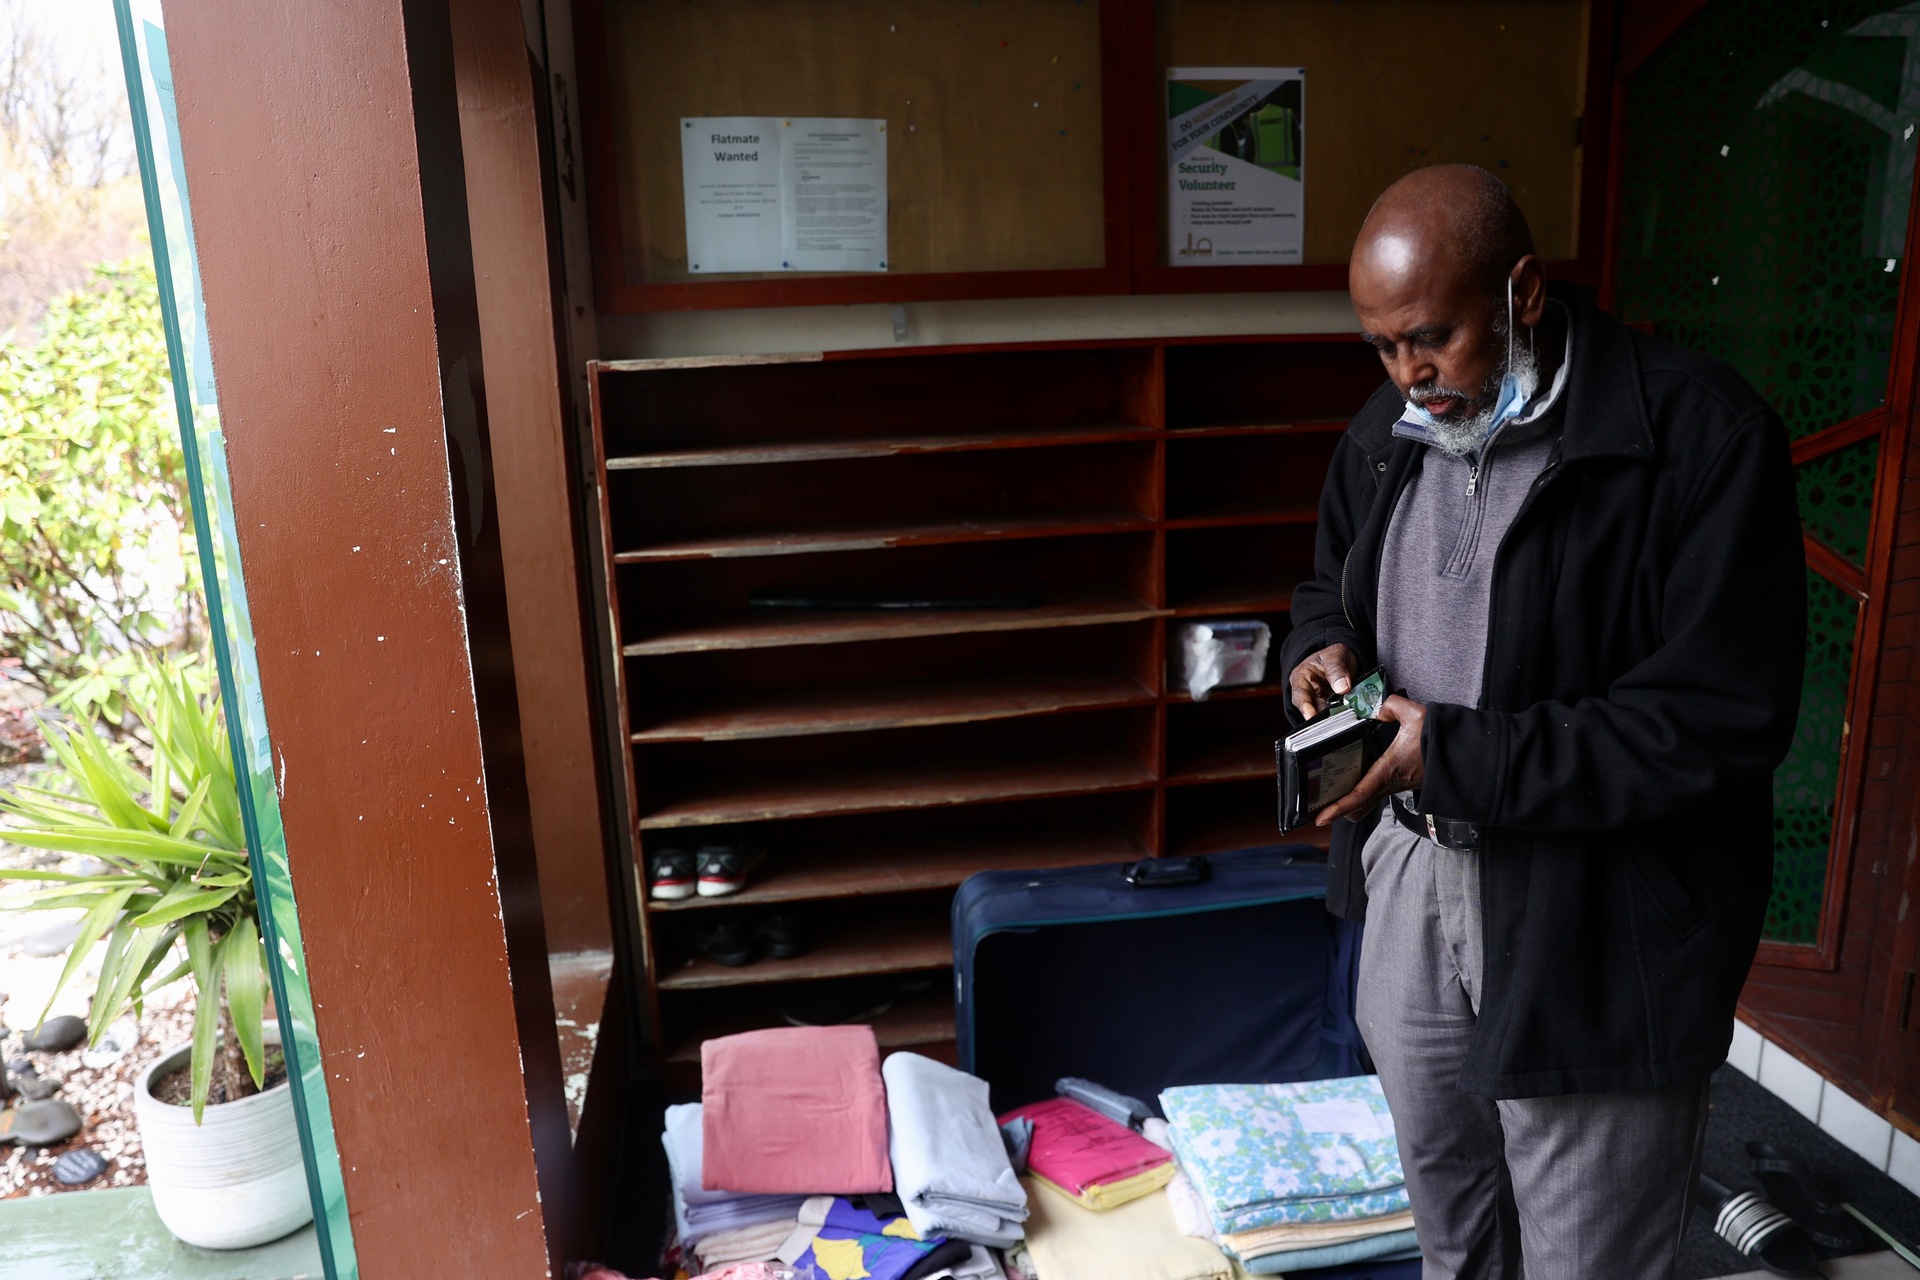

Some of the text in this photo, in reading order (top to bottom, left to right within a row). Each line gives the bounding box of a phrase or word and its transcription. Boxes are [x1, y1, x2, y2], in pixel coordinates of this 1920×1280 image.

[1171, 136, 1190, 151] FOR
[1188, 123, 1211, 140] YOUR
[1210, 93, 1258, 128] COMMUNITY
[1179, 120, 1193, 132] DO
[711, 133, 760, 145] Flatmate
[714, 151, 759, 162] Wanted
[1178, 162, 1228, 176] Security
[1178, 179, 1237, 191] Volunteer
